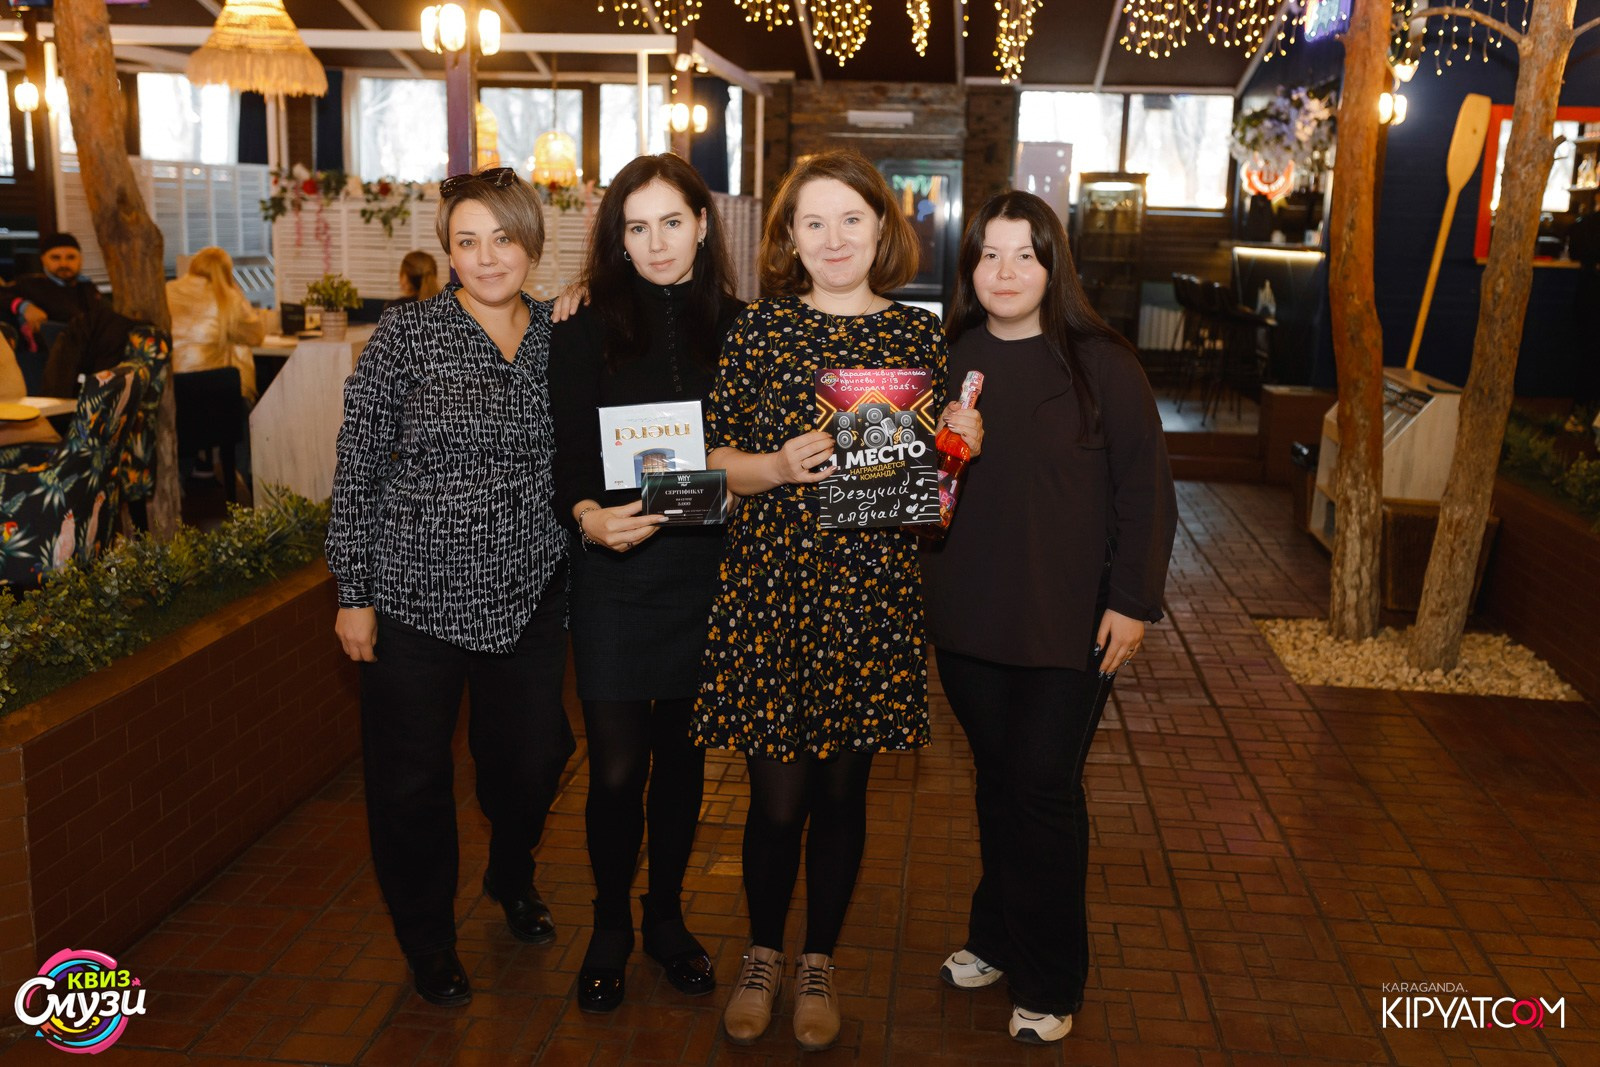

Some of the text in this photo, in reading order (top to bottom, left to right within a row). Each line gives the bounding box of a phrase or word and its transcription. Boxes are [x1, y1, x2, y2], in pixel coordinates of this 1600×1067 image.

[614, 423, 691, 441] merci
[845, 440, 926, 469] МЕСТО
[849, 461, 906, 476] НАГРАЖДАЕТСЯ
[860, 469, 896, 481] КОМАНДА
[829, 472, 909, 510] Везучий
[837, 498, 900, 526] случай
